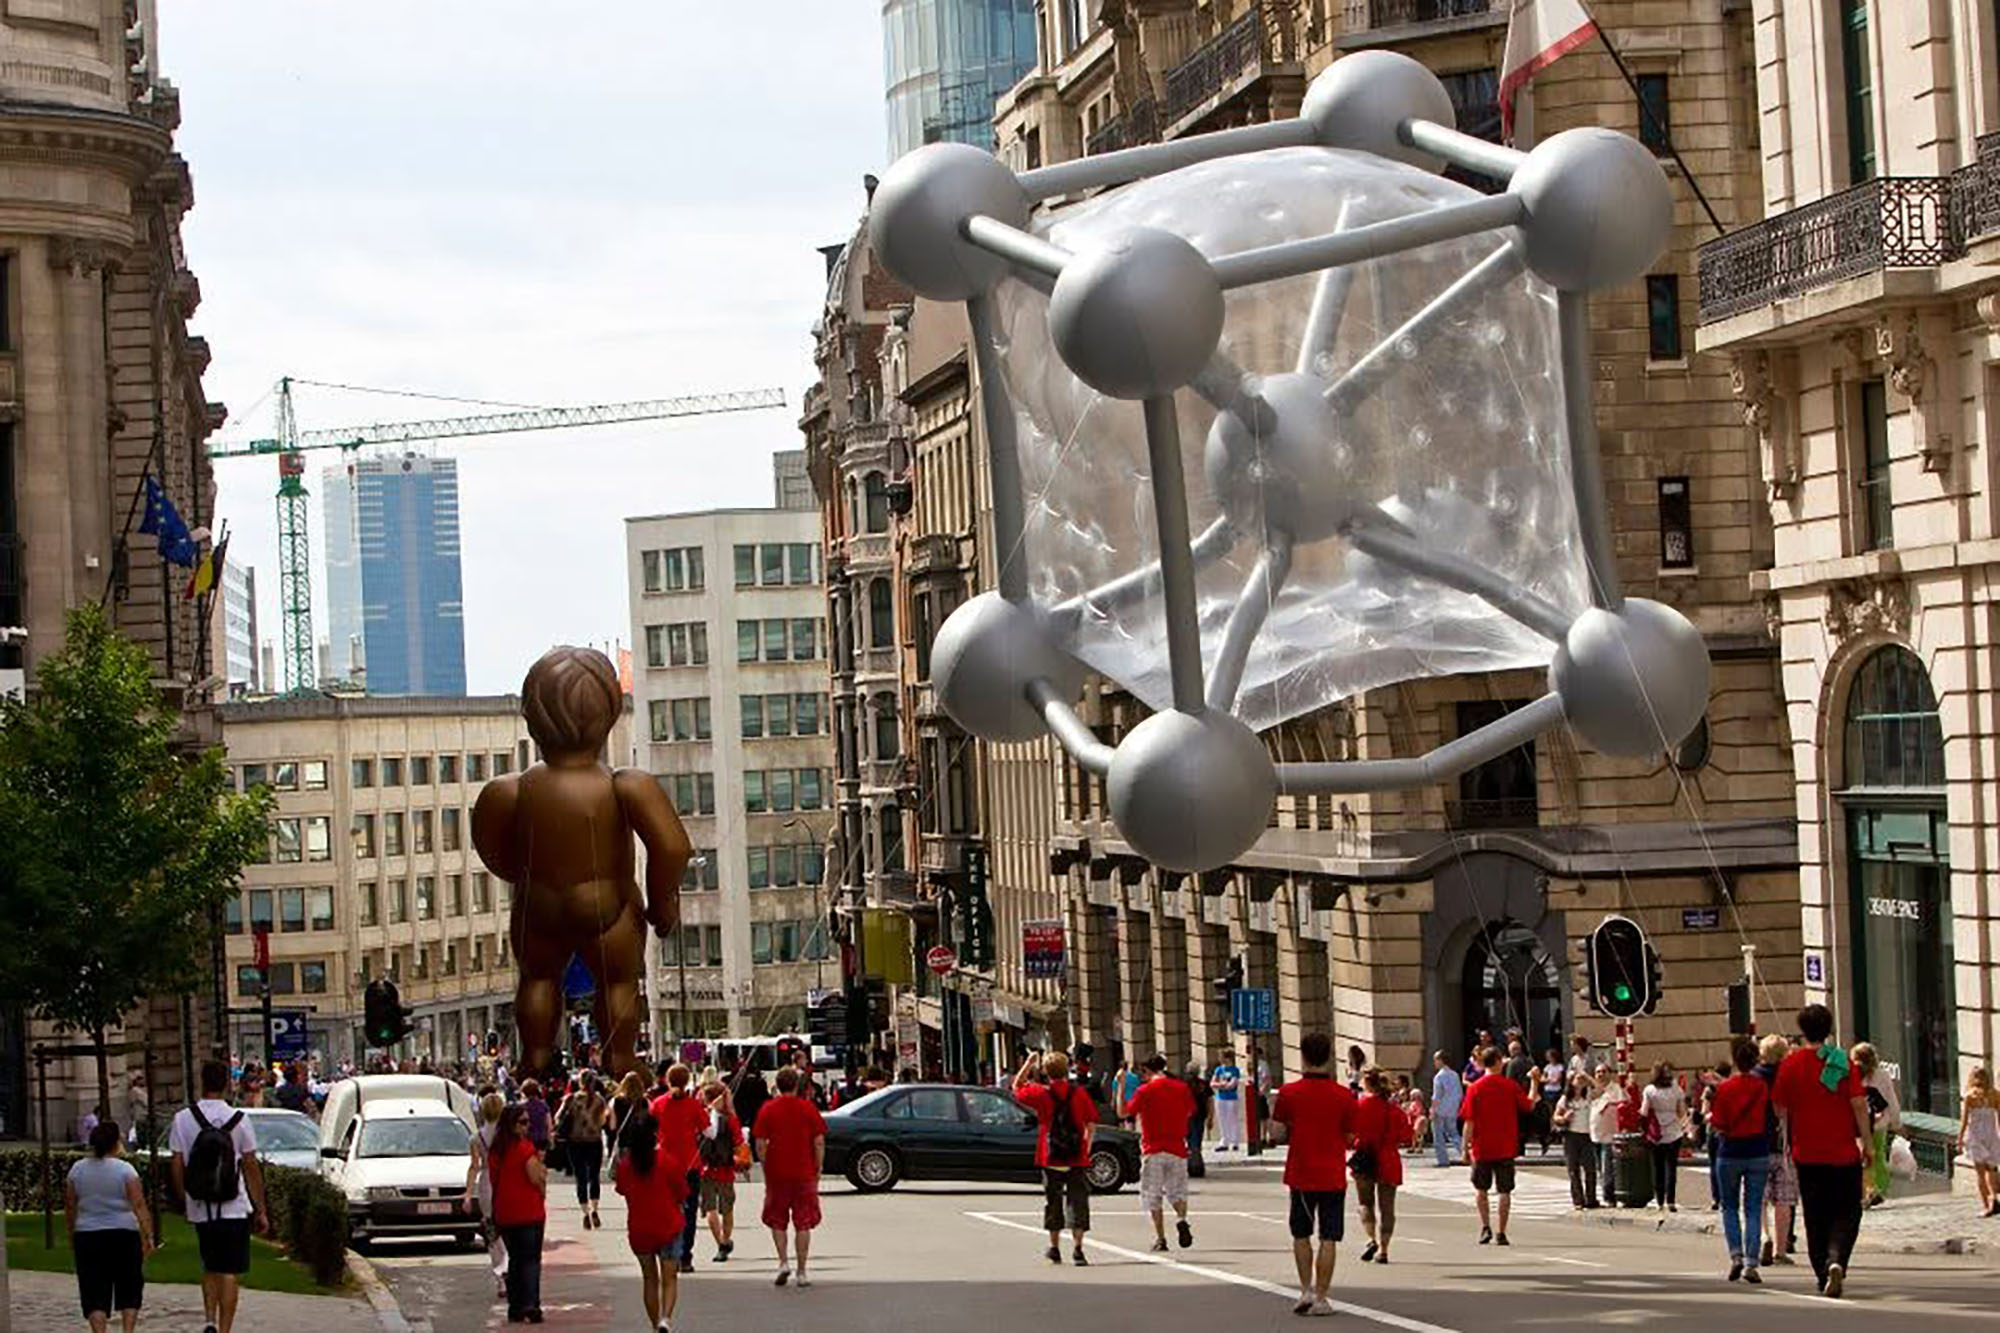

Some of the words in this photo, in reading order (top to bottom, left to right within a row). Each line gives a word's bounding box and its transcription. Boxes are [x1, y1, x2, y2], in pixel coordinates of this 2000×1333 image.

[968, 853, 978, 884] THE
[969, 895, 980, 958] OFFICE
[270, 1018, 289, 1045] P
